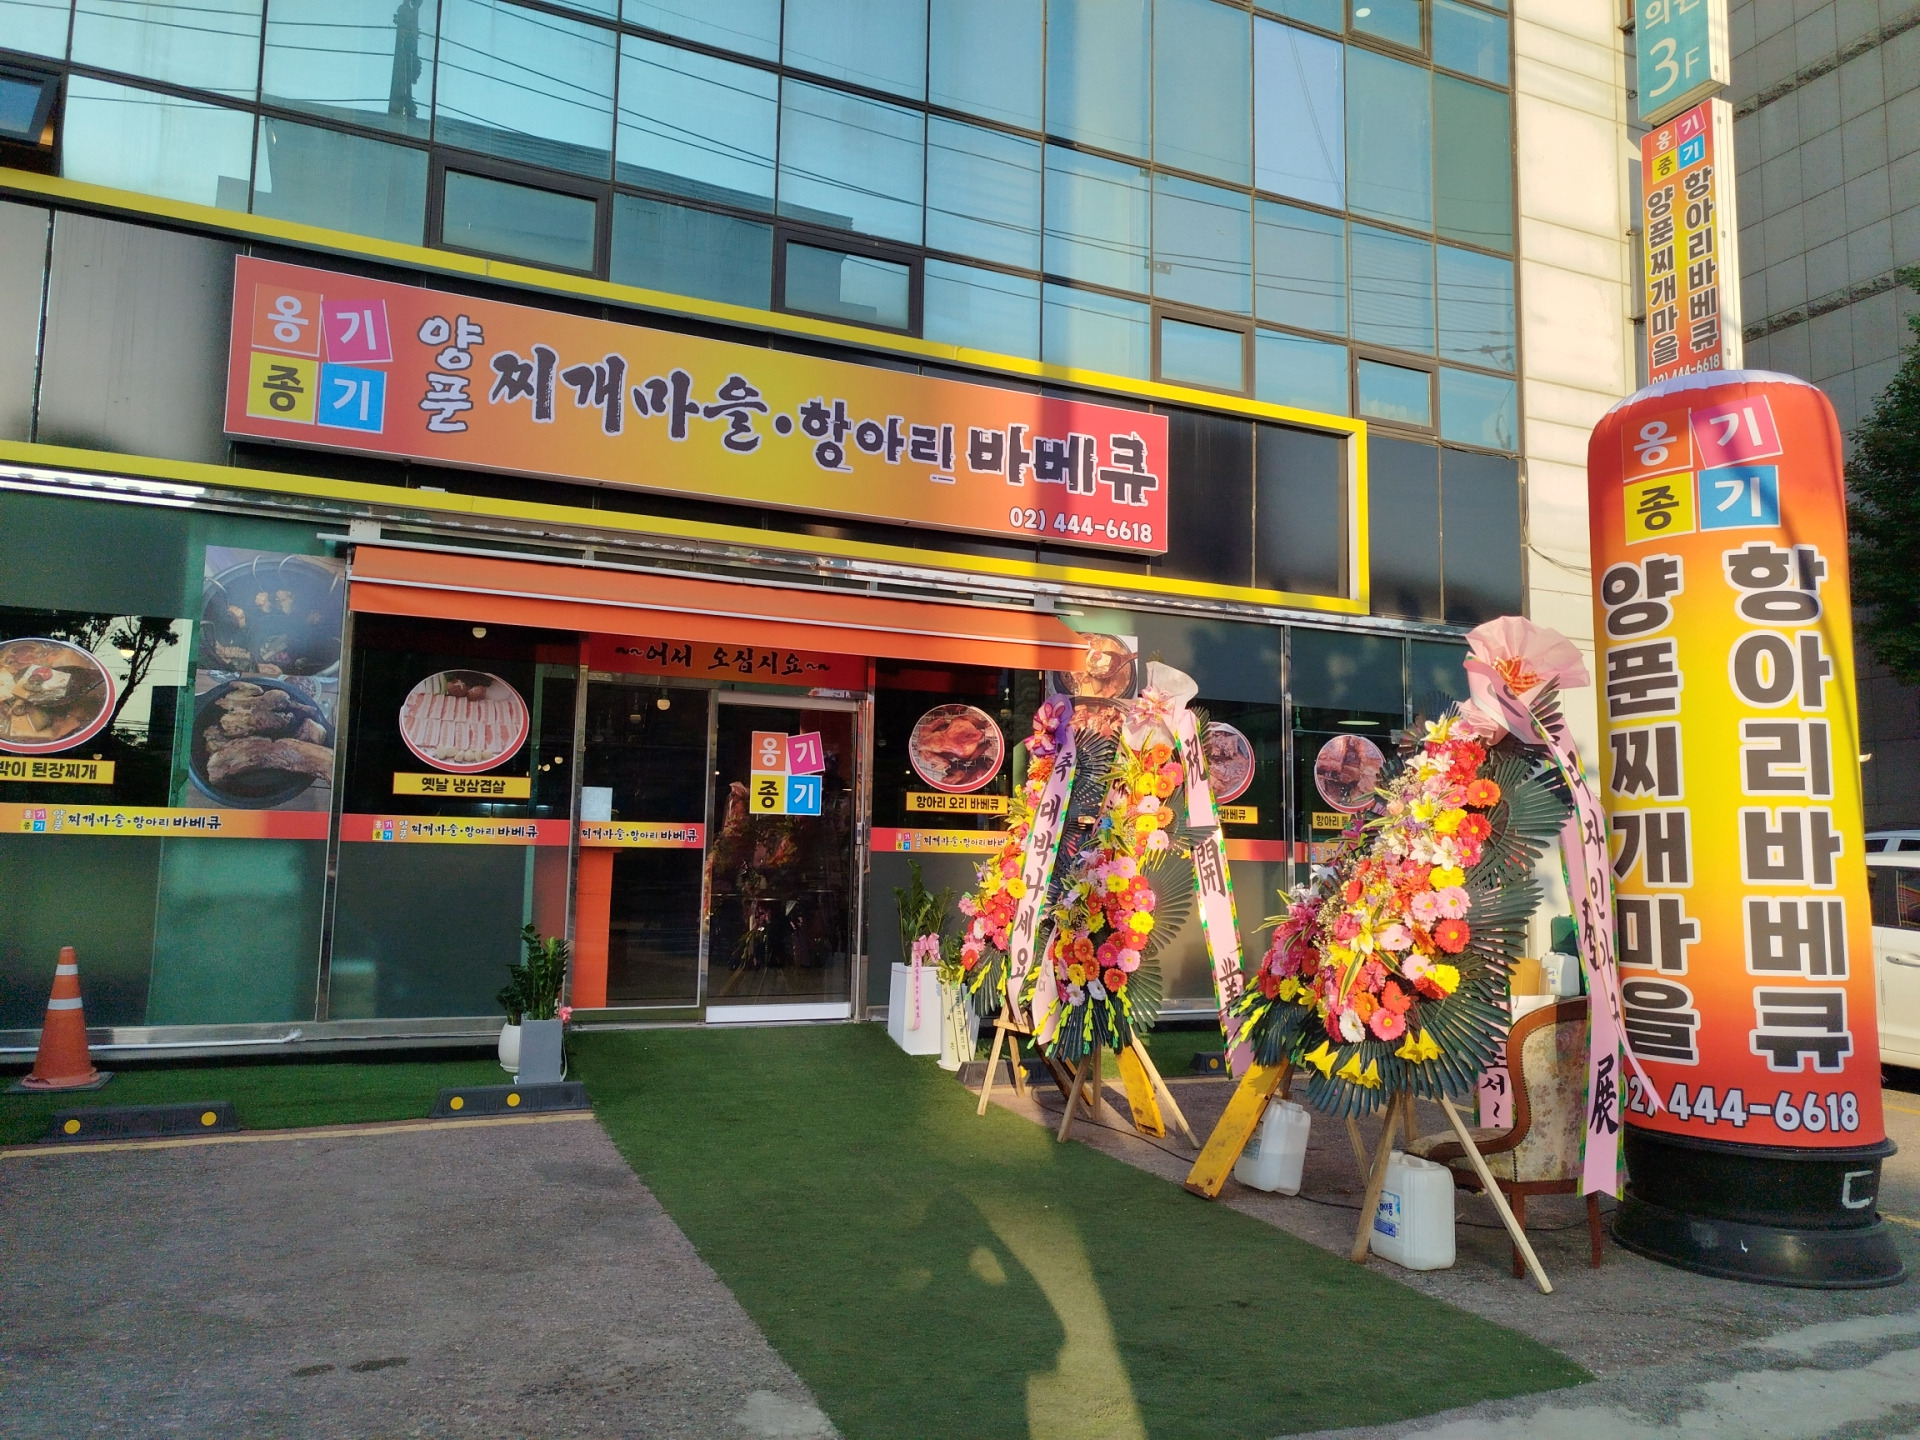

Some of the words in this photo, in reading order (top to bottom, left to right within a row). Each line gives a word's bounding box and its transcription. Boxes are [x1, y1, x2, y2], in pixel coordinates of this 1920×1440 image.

[1672, 353, 1721, 379] 444-6618
[1008, 506, 1047, 532] 02)
[1052, 511, 1153, 545] 444-6618
[32, 762, 98, 780] 된장찌개
[421, 777, 449, 793] 옛날
[453, 778, 506, 795] 냉삼겹살
[916, 796, 946, 810] 항아리
[948, 797, 968, 810] 오리
[970, 797, 1000, 811] 바베큐
[1316, 814, 1339, 827] 항아리
[1668, 1083, 1861, 1134] 444-6618
